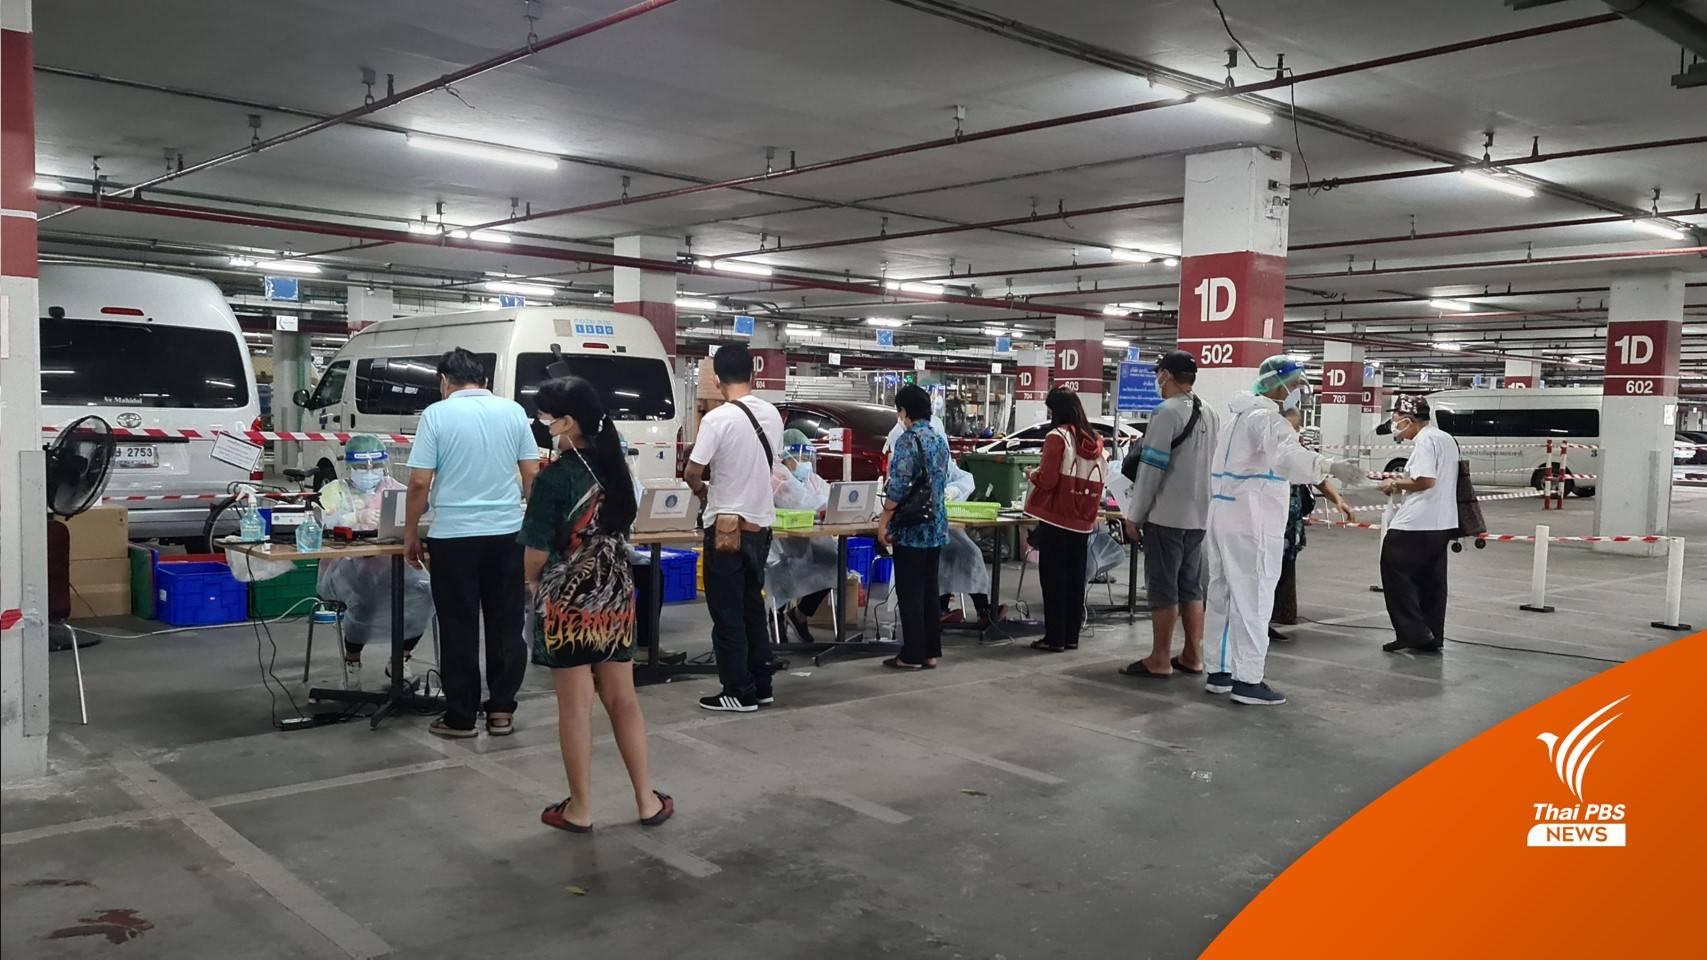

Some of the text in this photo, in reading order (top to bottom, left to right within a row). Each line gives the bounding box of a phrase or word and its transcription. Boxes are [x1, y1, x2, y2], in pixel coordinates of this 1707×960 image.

[1194, 277, 1237, 322] 1D
[1201, 343, 1233, 365] 502
[1615, 335, 1654, 365] 1D
[1058, 349, 1079, 370] 1D
[1019, 372, 1032, 386] 1D
[1326, 369, 1346, 387] 1D
[1626, 380, 1653, 394] 602
[1332, 395, 1346, 404] 703
[127, 447, 153, 458] 2753
